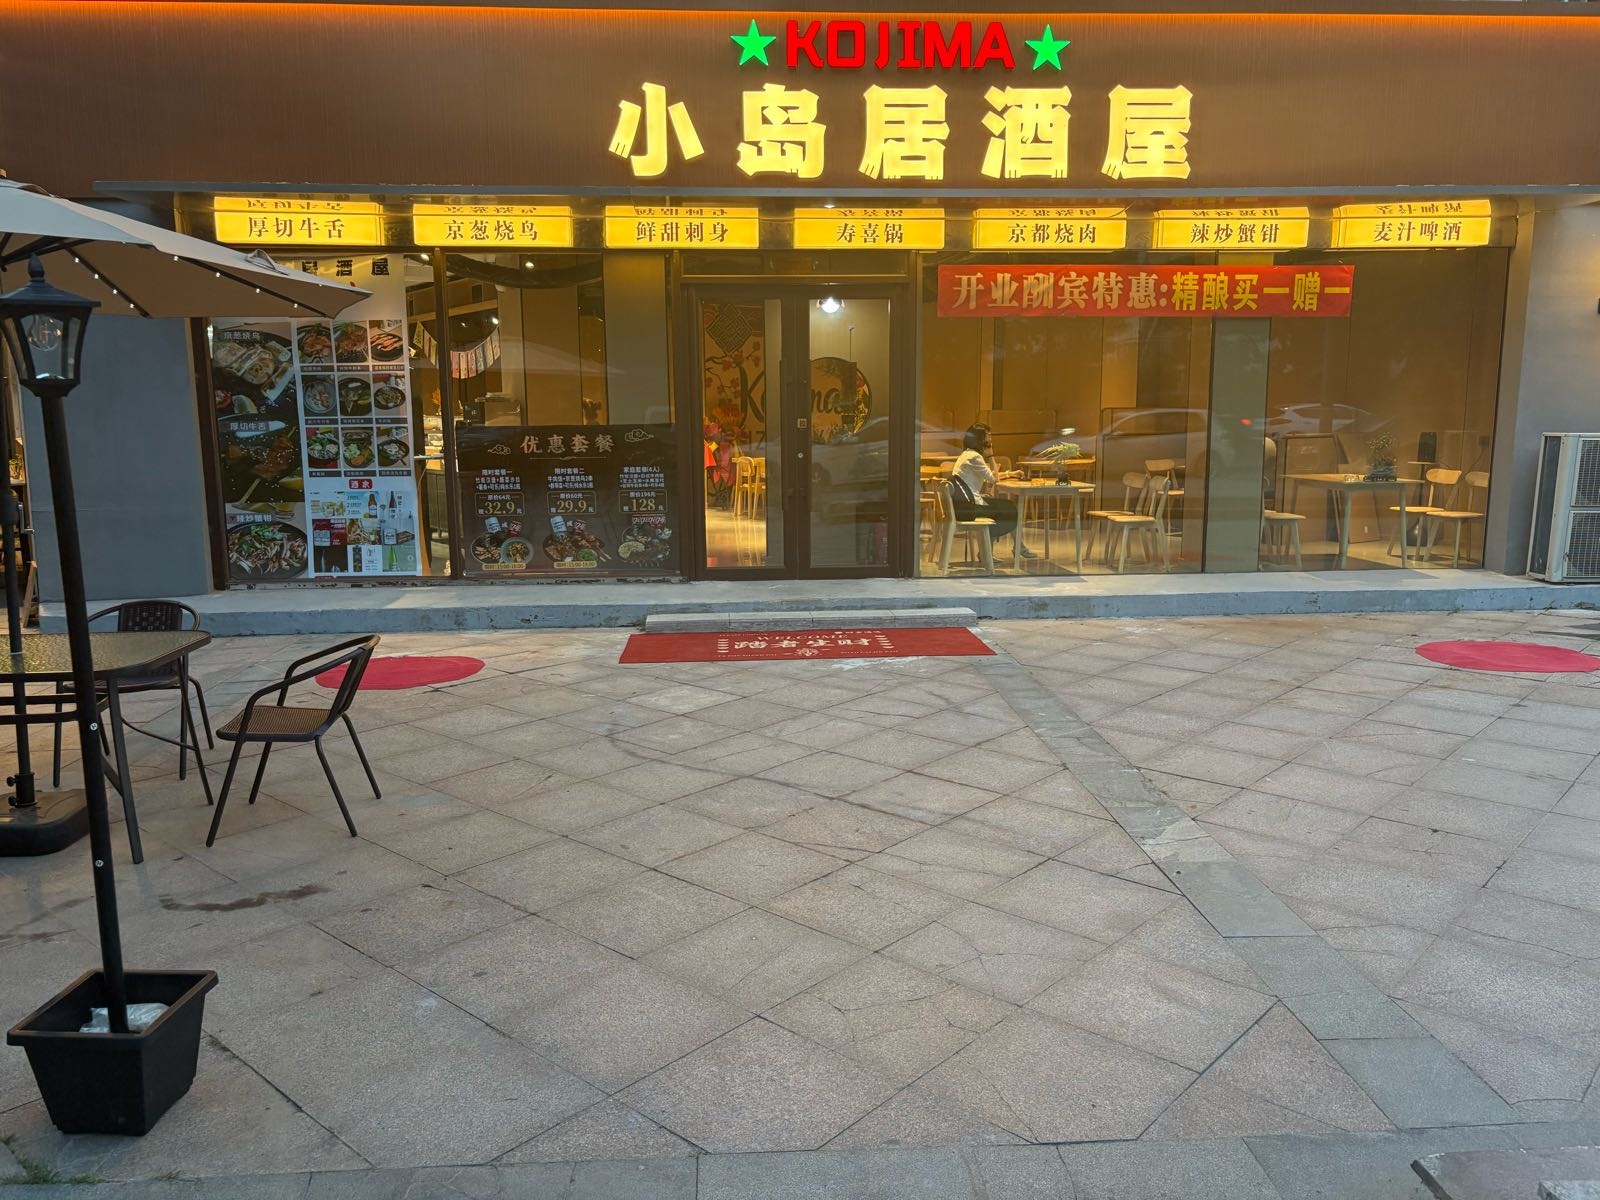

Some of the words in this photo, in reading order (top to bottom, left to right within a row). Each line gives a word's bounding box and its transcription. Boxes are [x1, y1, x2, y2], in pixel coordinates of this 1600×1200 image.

[786, 20, 1016, 68] KOJIMA
[608, 82, 1194, 180] 小岛居酒屋
[248, 216, 346, 240] 厚切牛舌
[445, 219, 539, 242] 京葱烧鸟
[635, 220, 729, 243] 鲜甜刺身
[836, 222, 904, 244] 寿喜锅
[1007, 222, 1097, 244] 京都烧肉
[1190, 222, 1280, 244] 辣炒蟹钳
[1373, 221, 1462, 242] 麦汁啤酒
[519, 433, 616, 454] 优惠套餐
[485, 501, 515, 515] 32.9
[557, 500, 587, 514] 29.9
[631, 498, 656, 512] 128
